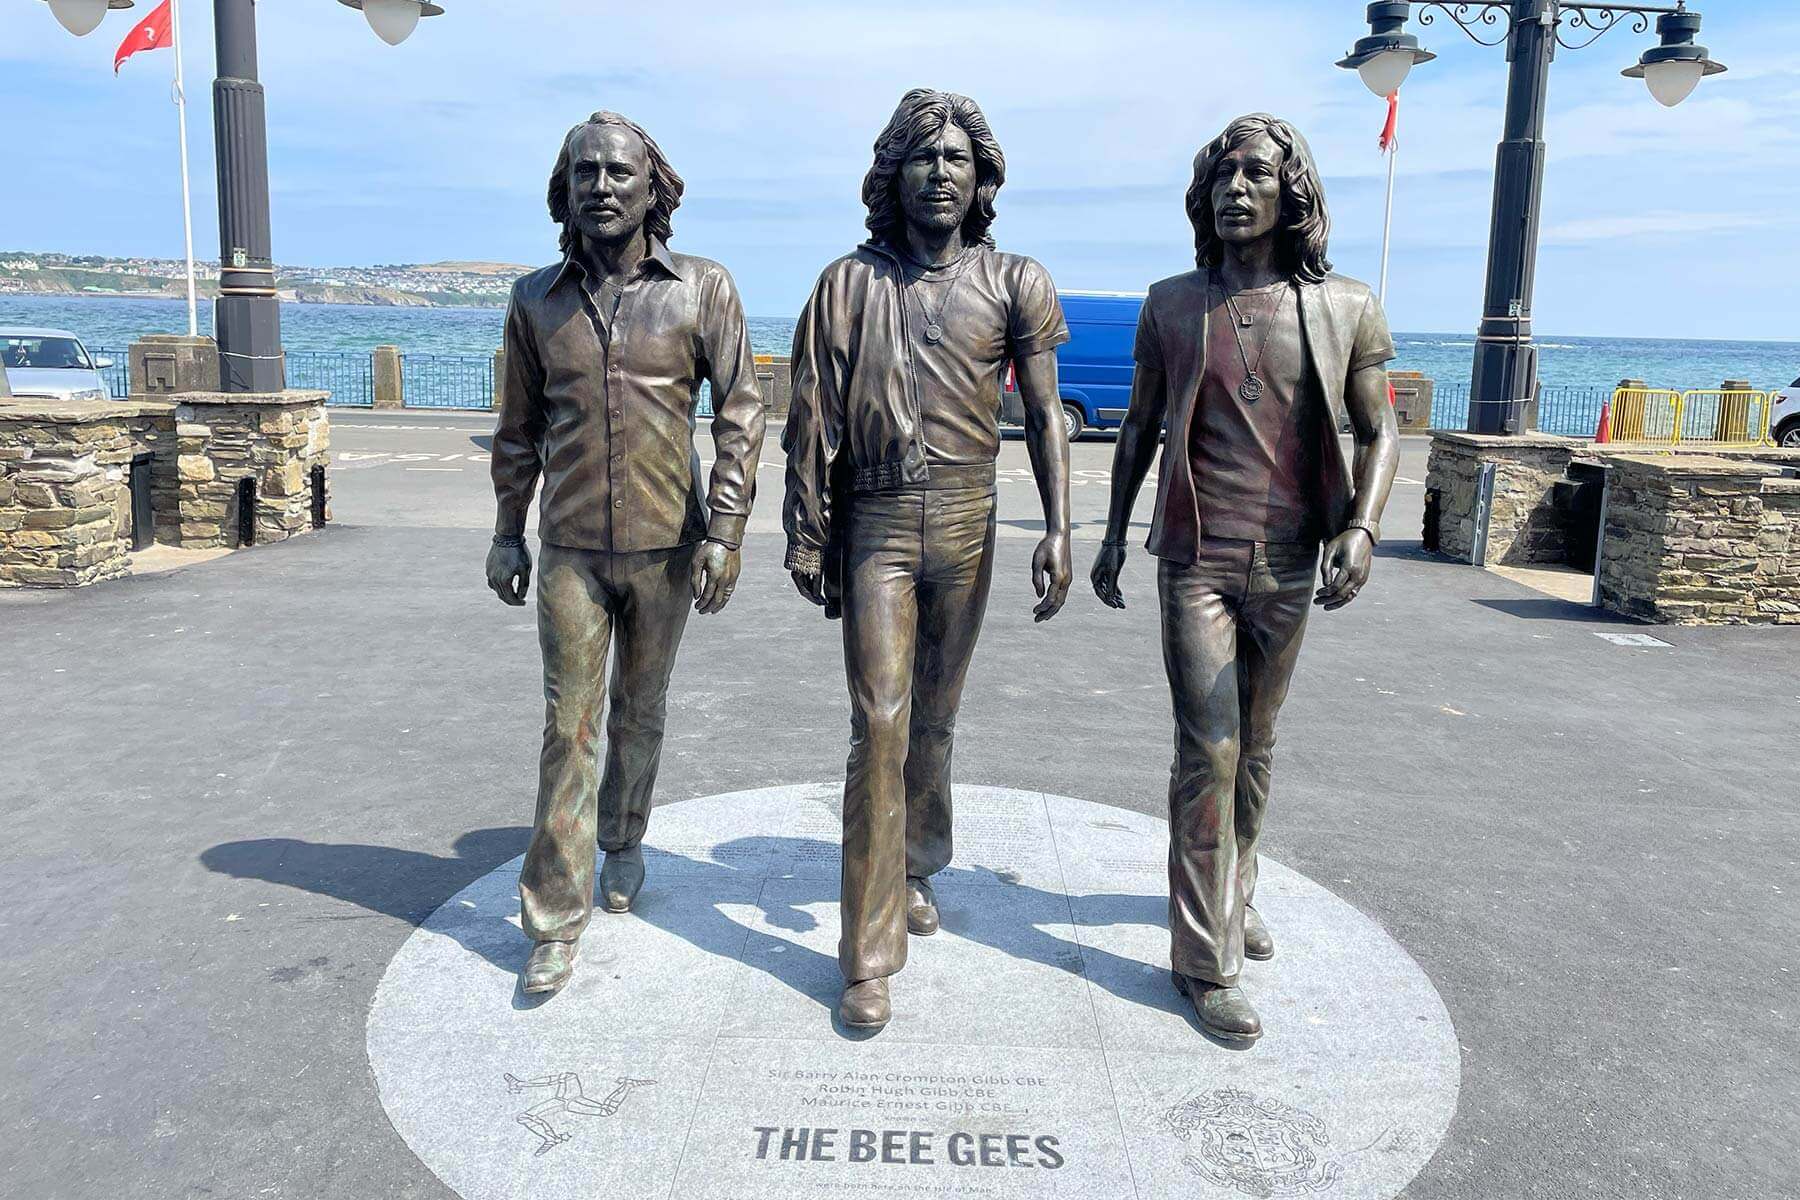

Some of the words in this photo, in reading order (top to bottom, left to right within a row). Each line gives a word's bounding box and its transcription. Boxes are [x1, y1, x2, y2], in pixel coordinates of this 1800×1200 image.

[768, 1069, 791, 1080] Sir
[795, 1070, 838, 1081] Barry
[843, 1071, 879, 1081] Alan
[885, 1073, 966, 1084] Crompton
[972, 1075, 1010, 1085] Gibb
[1016, 1077, 1047, 1087] CBE
[819, 1083, 865, 1094] Robin
[872, 1086, 914, 1097] Hugh
[920, 1087, 959, 1097] Gibb
[964, 1088, 997, 1098] CBE
[801, 1097, 871, 1108] Maurice
[876, 1099, 930, 1110] Ernest
[935, 1101, 975, 1112] Gibb
[980, 1102, 1012, 1113] CBE
[753, 1126, 839, 1162] THE
[848, 1129, 935, 1165] BEE
[947, 1131, 1066, 1170] GEES
